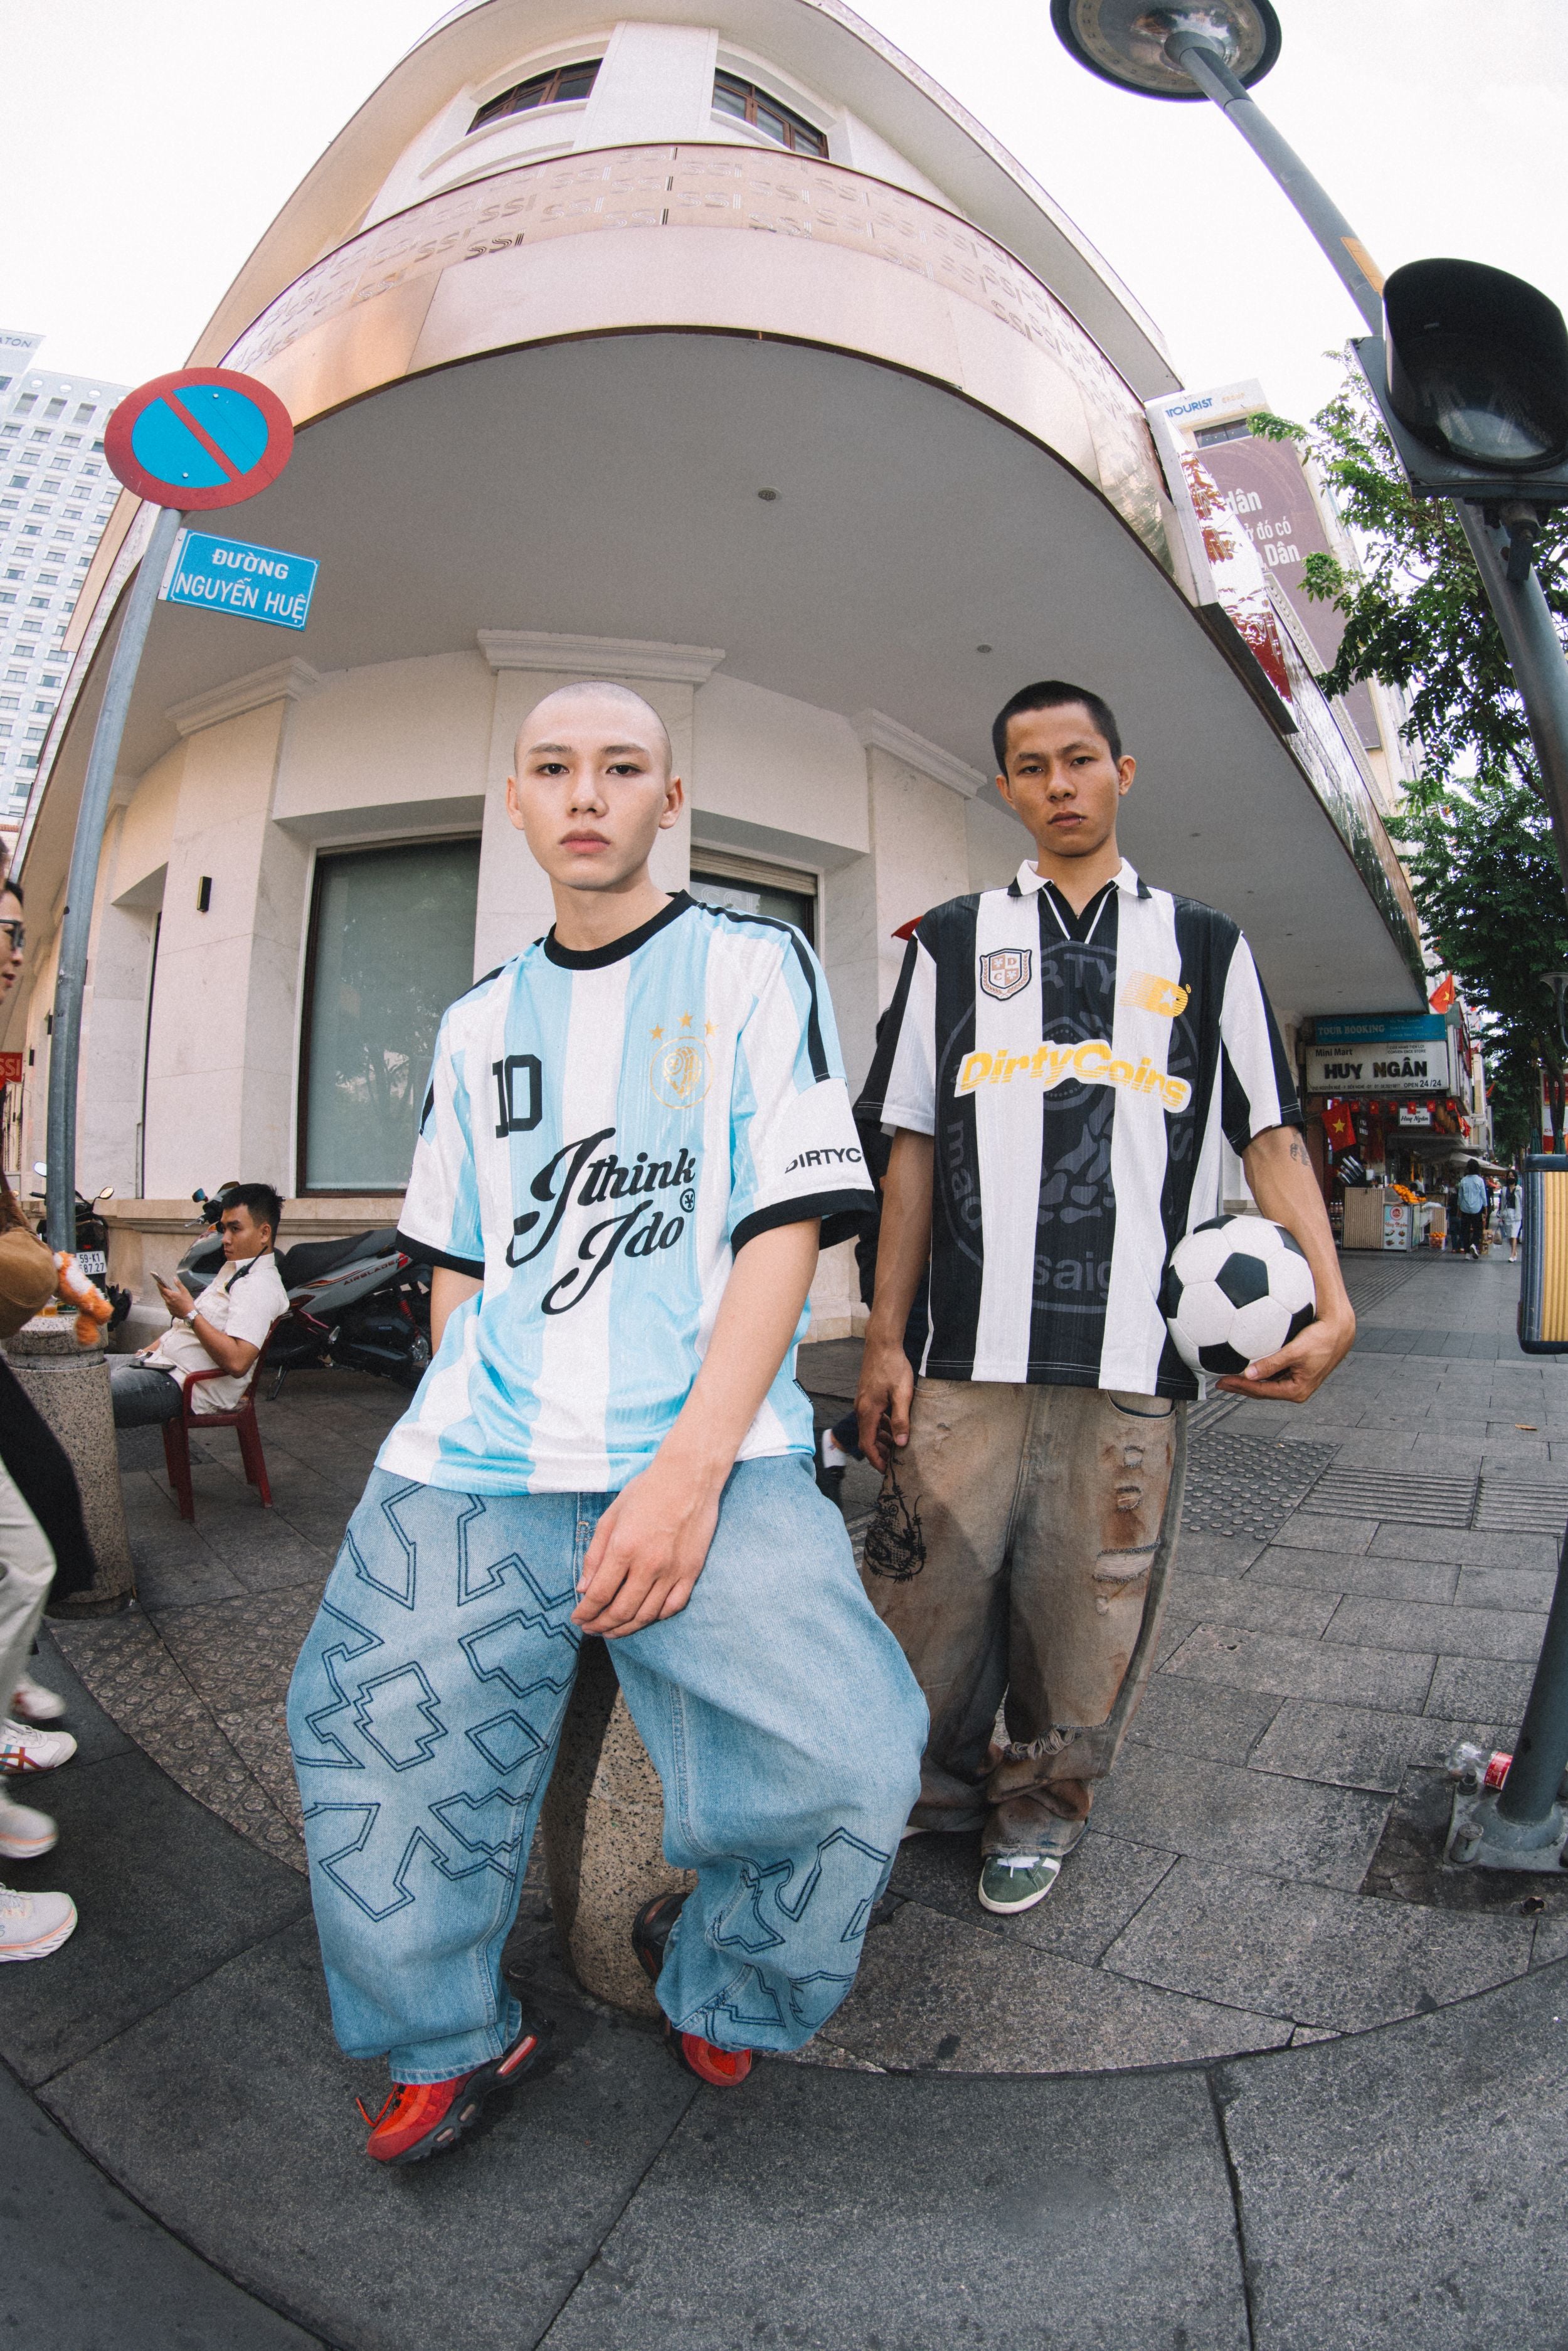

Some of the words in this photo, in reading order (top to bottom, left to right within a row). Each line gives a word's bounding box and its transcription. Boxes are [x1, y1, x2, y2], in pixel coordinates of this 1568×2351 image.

[477, 194, 537, 225] SSI
[463, 227, 527, 261] SSI
[1275, 516, 1292, 536] có
[212, 548, 290, 580] ĐƯỜNG
[1264, 541, 1301, 566] Dân
[175, 572, 259, 609] NGUYỄN
[264, 591, 306, 624] HUỆ
[1318, 1026, 1342, 1036] TOUR
[1344, 1024, 1385, 1034] BOOKING
[1315, 1048, 1332, 1057] Mini
[1334, 1048, 1352, 1056] Mart
[960, 1044, 1187, 1108] DirtyCoins
[1324, 1063, 1363, 1080] HUY
[1373, 1057, 1428, 1078] NGÂN
[492, 1054, 543, 1138] 10
[80, 1253, 100, 1263] 59-K1
